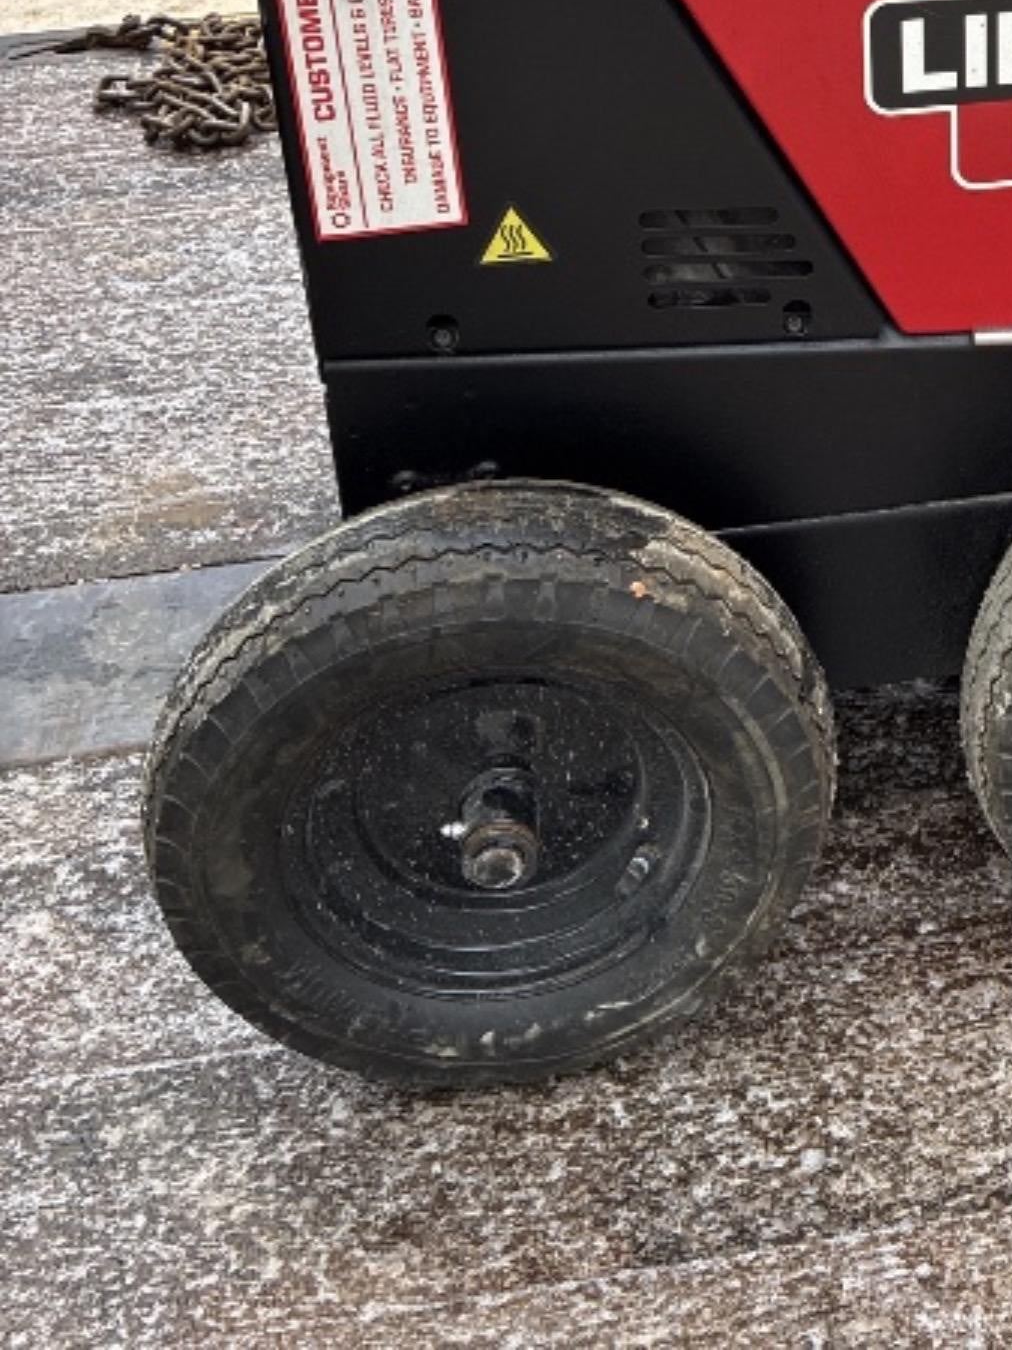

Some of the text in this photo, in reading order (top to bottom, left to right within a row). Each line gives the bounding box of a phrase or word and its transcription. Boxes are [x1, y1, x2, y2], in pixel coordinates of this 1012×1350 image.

[385, 47, 404, 82] FLAT
[411, 32, 439, 123] EQUIPMENT
[391, 94, 419, 184] INSURANCE
[424, 128, 441, 146] TO
[374, 162, 395, 213] CHECK
[428, 150, 450, 213] DAMAGE
